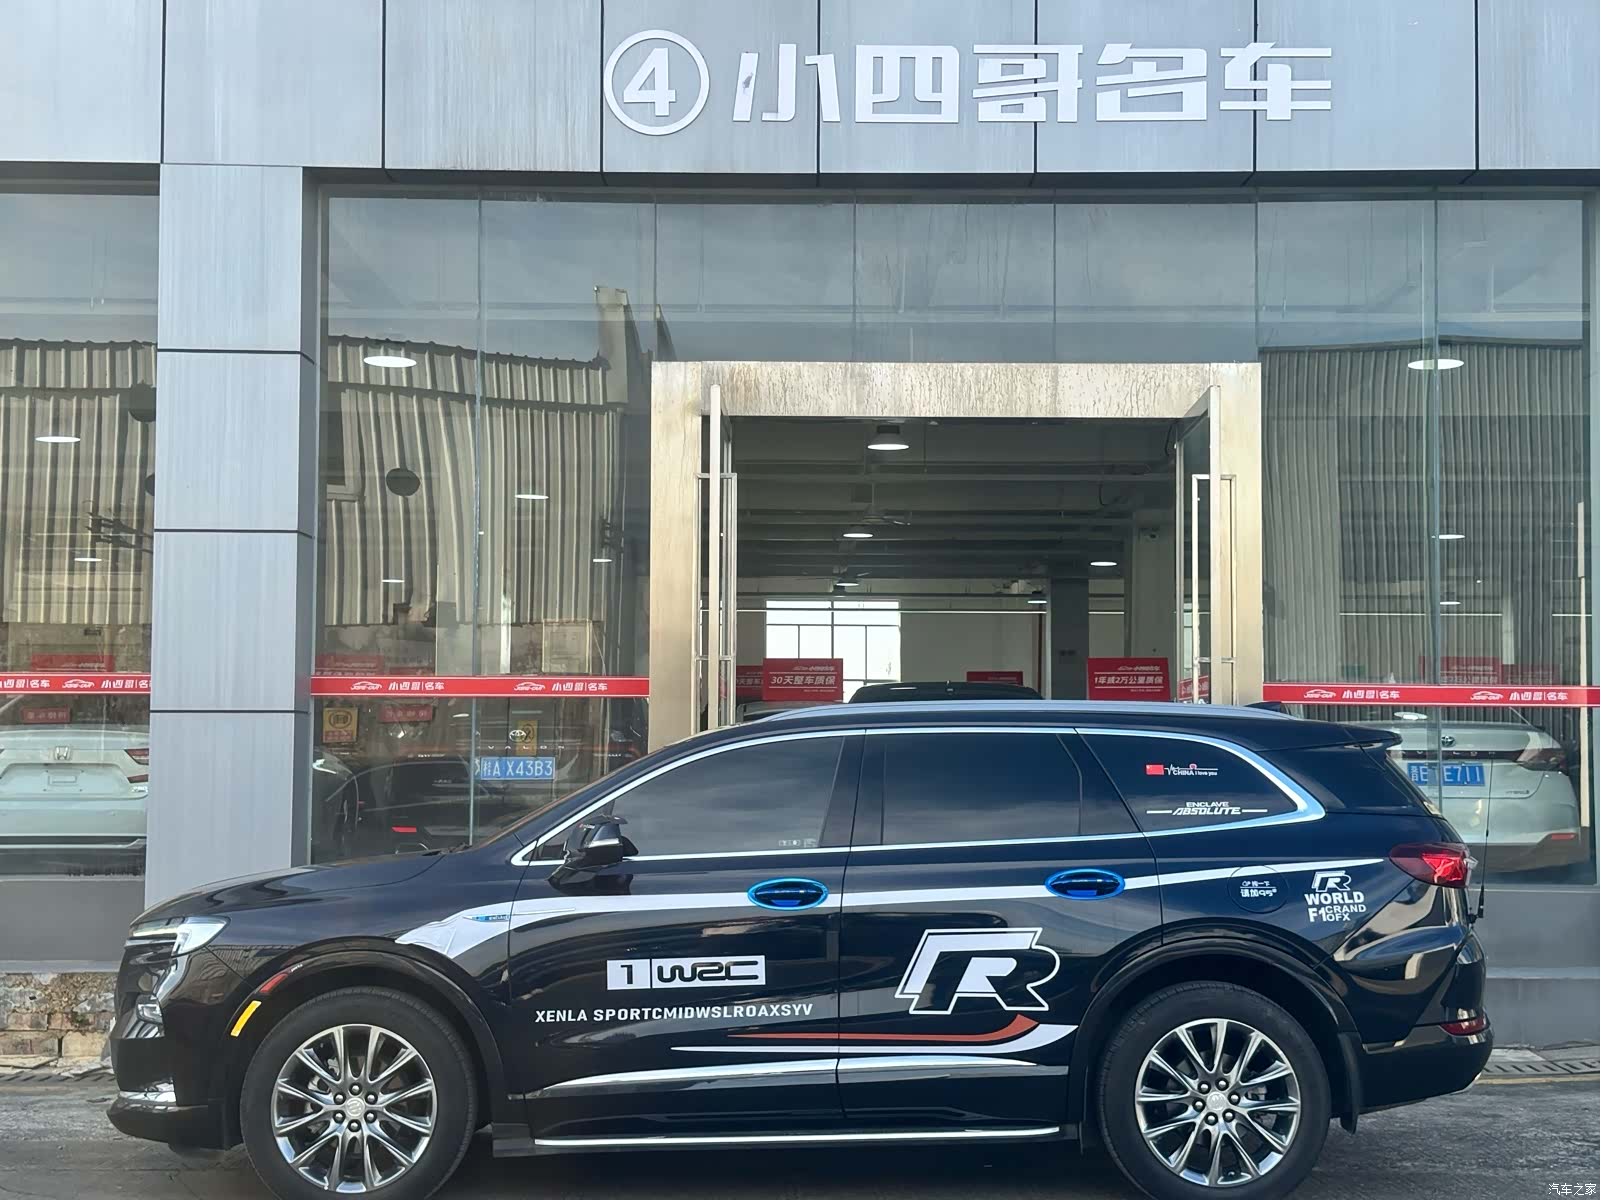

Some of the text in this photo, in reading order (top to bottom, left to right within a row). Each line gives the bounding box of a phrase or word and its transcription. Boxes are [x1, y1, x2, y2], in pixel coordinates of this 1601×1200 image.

[732, 42, 1332, 123] 小四哥名车
[1172, 807, 1242, 816] ABSOLUTE
[1304, 891, 1365, 906] WORLD
[1307, 907, 1327, 922] F1
[1326, 913, 1351, 922] OFX
[535, 1003, 813, 1023] XENLA SPORTCMIDWSLROAXSYV
